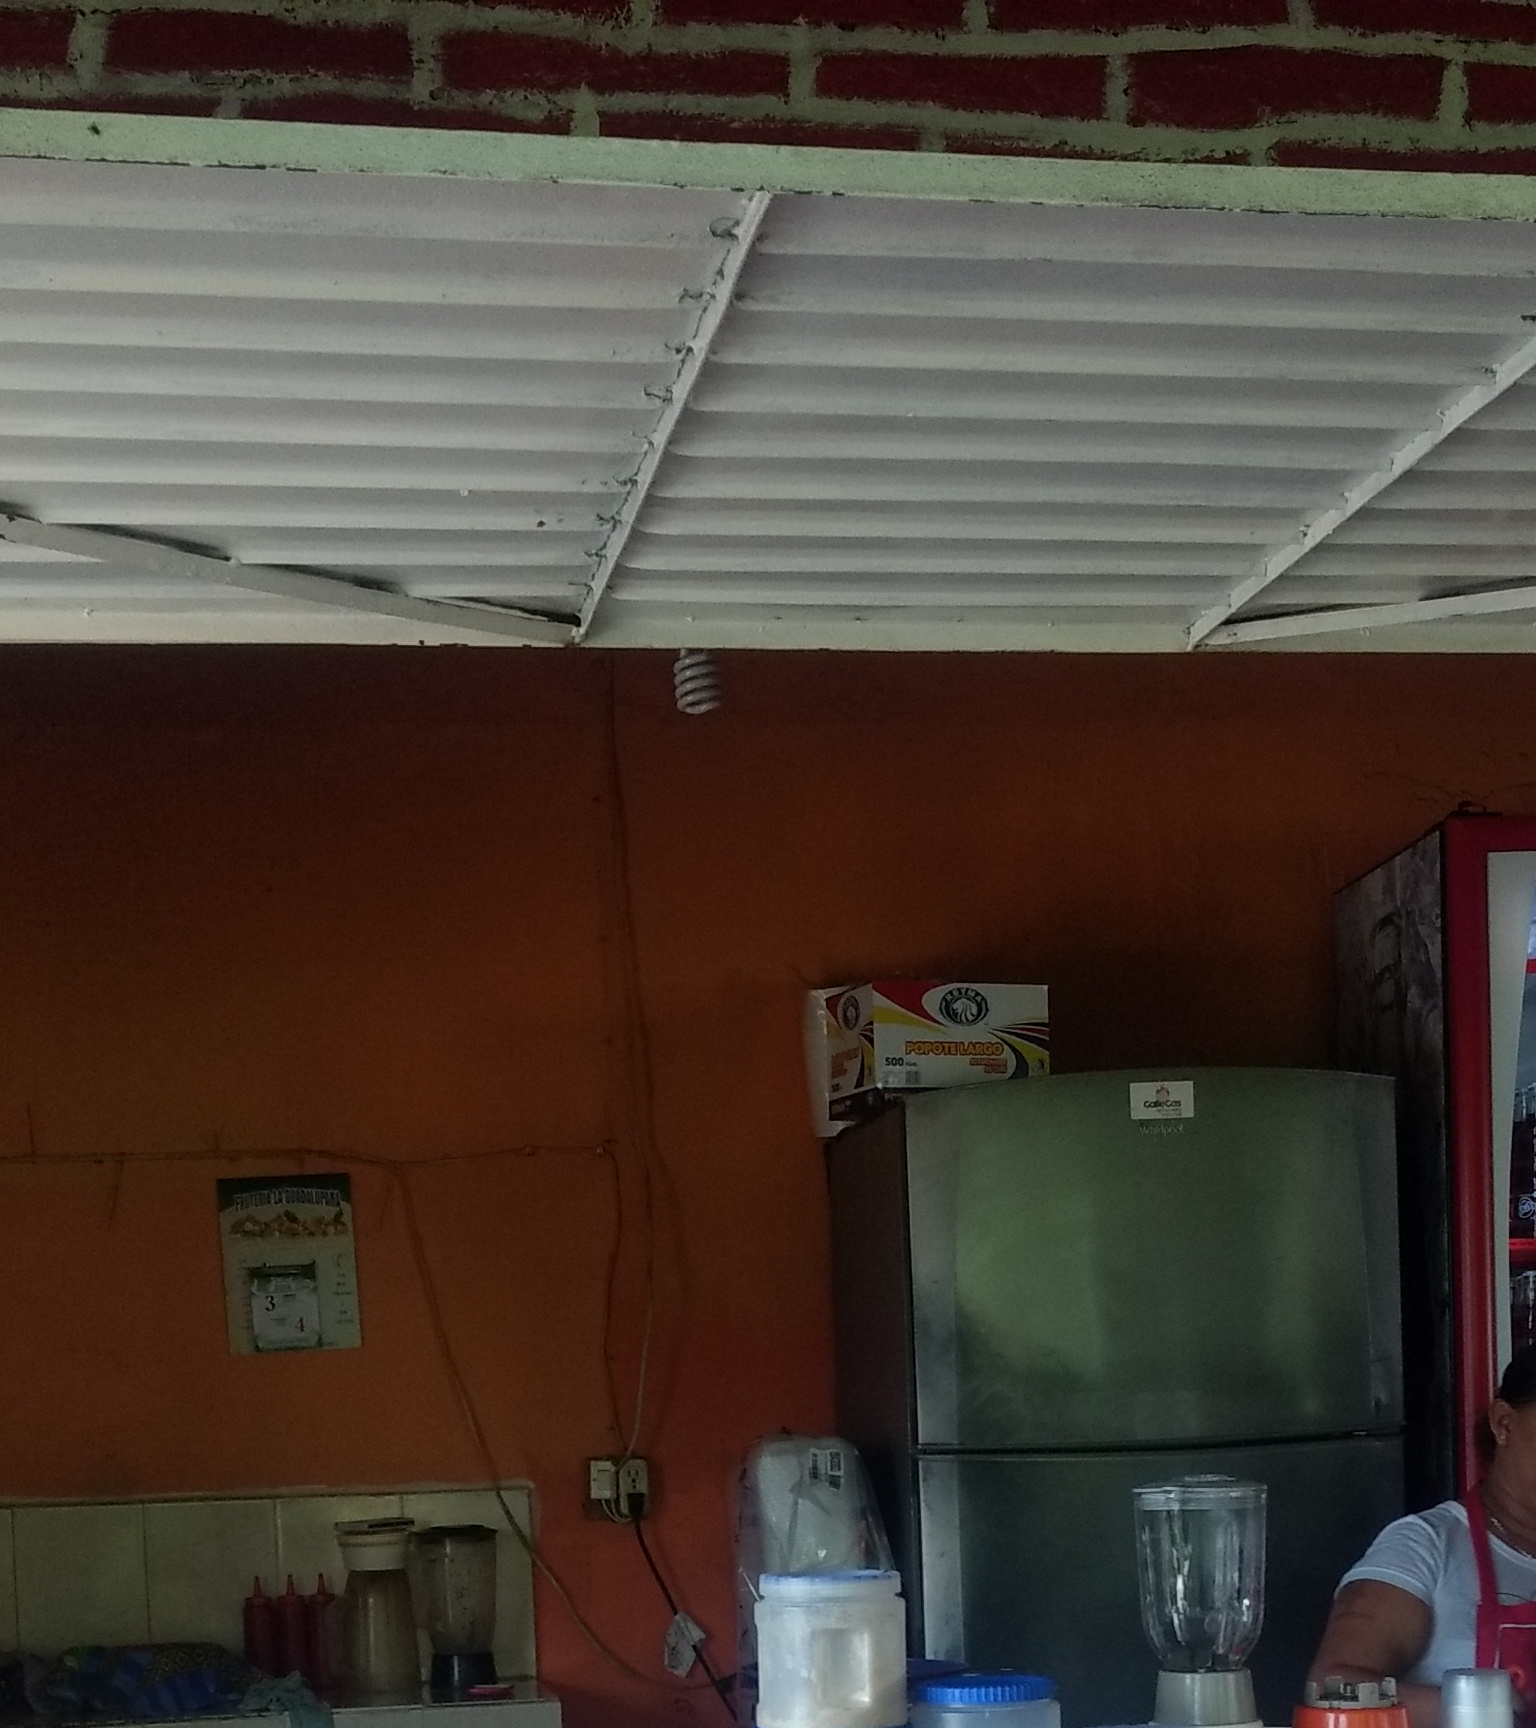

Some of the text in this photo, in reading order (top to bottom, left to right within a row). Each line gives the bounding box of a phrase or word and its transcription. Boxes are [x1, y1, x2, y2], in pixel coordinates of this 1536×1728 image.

[944, 988, 983, 1003] REYMA
[905, 1041, 1004, 1056] POPOTE LARGO
[884, 1057, 904, 1067] 500
[265, 1295, 276, 1312] 3
